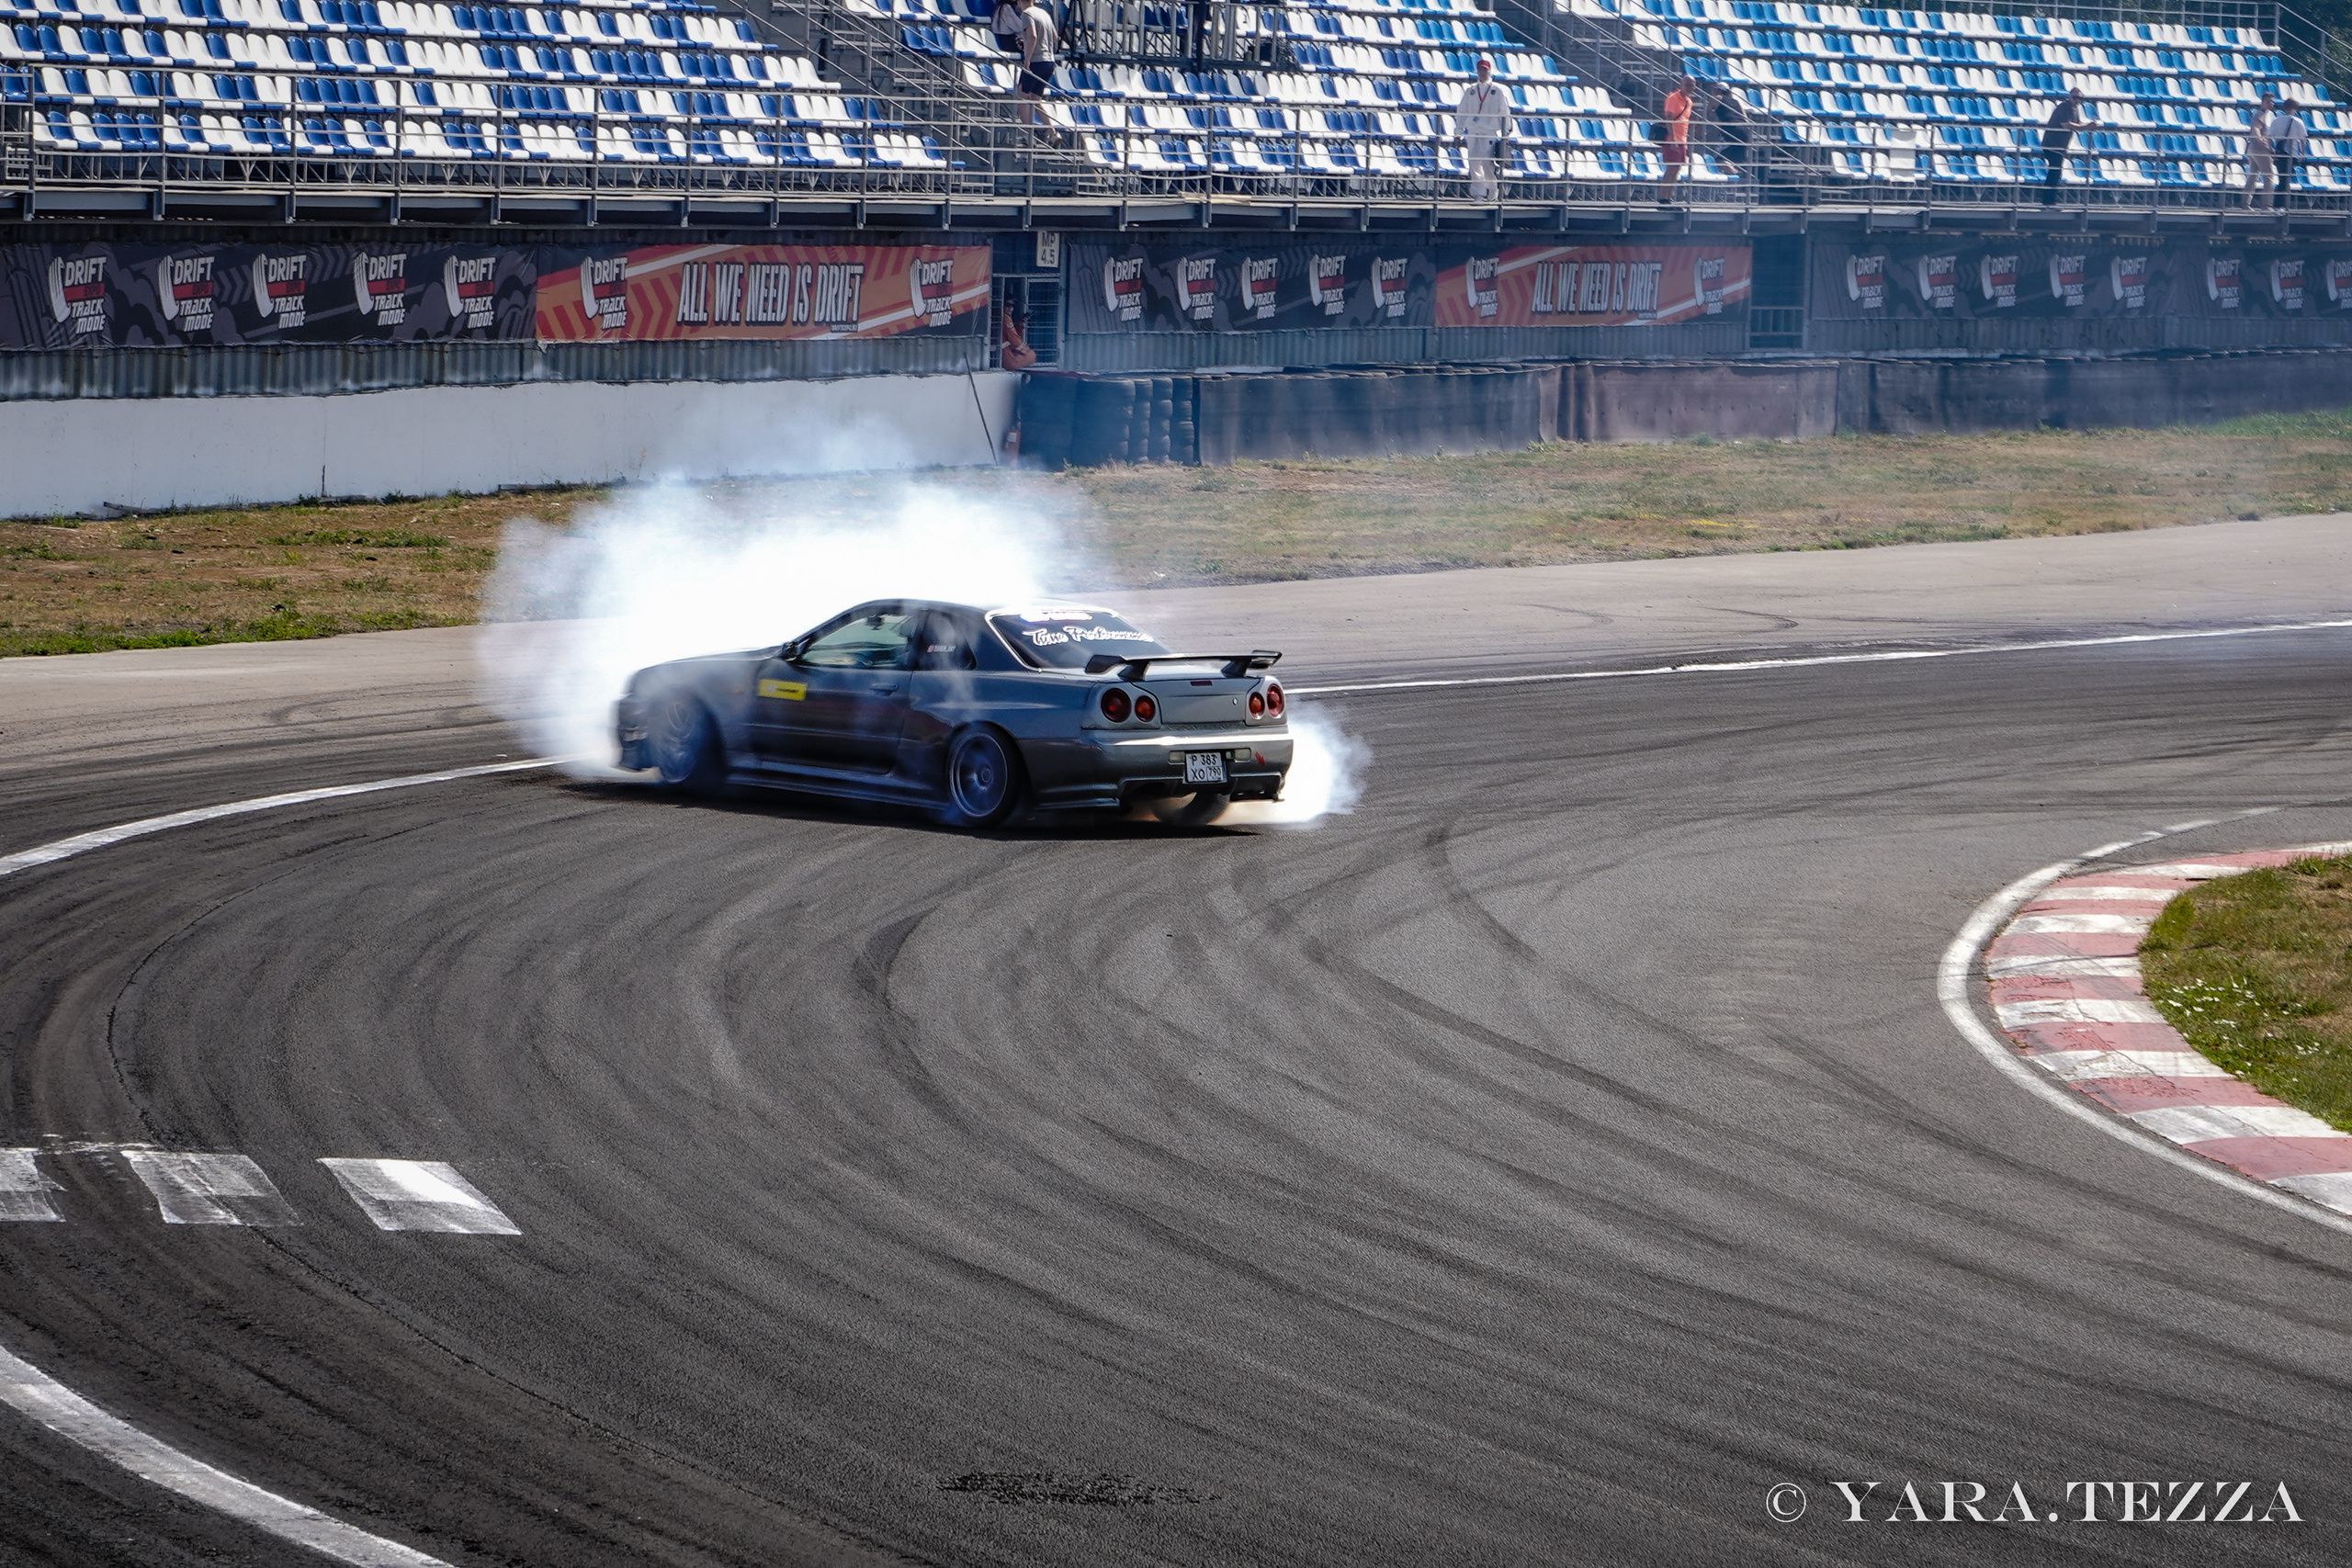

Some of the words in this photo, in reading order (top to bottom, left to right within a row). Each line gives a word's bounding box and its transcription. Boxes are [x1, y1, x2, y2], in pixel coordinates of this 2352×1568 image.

[1042, 231, 1056, 247] MP
[65, 257, 107, 287] DRIFT
[174, 257, 215, 285] DRIFT
[268, 255, 307, 283] DRIFT
[368, 254, 406, 280] DRIFT
[459, 257, 496, 283] DRIFT
[594, 257, 628, 285] DRIFT
[922, 259, 954, 286] DRIFT
[1114, 258, 1143, 282] DRIFT
[1188, 258, 1216, 281] DRIFT
[1251, 258, 1278, 281] DRIFT
[1319, 255, 1346, 278] DRIFT
[1382, 258, 1408, 280] DRIFT
[1475, 258, 1499, 280] DRIFT
[1702, 258, 1724, 279] DRIFT
[1857, 256, 1884, 276] DRIFT
[1929, 256, 1957, 276] DRIFT
[1991, 256, 2018, 275] DRIFT
[2060, 255, 2086, 274] DRIFT
[2121, 257, 2147, 276] DRIFT
[2216, 260, 2241, 276] DRIFT
[2279, 261, 2304, 277] DRIFT
[677, 263, 708, 322] ALL
[715, 263, 744, 322] WE
[746, 263, 790, 322] NEED
[792, 263, 813, 322] IS
[814, 264, 864, 322] DRIFT
[1323, 288, 1343, 303] TRACK
[1532, 262, 1554, 311] ALL
[1557, 262, 1578, 311] WE
[1580, 262, 1611, 311] NEED
[1612, 262, 1626, 311] IS
[1627, 263, 1662, 311] DRIFT
[179, 298, 211, 316] TRACK
[275, 296, 304, 312] TRACK
[374, 293, 404, 311] TRACK
[464, 296, 493, 312] TRACK
[599, 297, 627, 314] TRACK
[926, 296, 952, 312] TRACK
[1118, 293, 1141, 308] TRACK
[1192, 293, 1214, 308] TRACK
[1254, 291, 1276, 306] TRACK
[1385, 290, 1405, 305] TRACK
[72, 299, 104, 317] TRACK
[378, 309, 405, 326] MODE
[75, 314, 106, 333] MODE
[184, 313, 213, 332] MODE
[278, 311, 306, 330] MODE
[468, 311, 494, 329] MODE
[603, 311, 628, 329] MODE
[930, 311, 953, 327] MODE
[1200, 754, 1217, 765] 383
